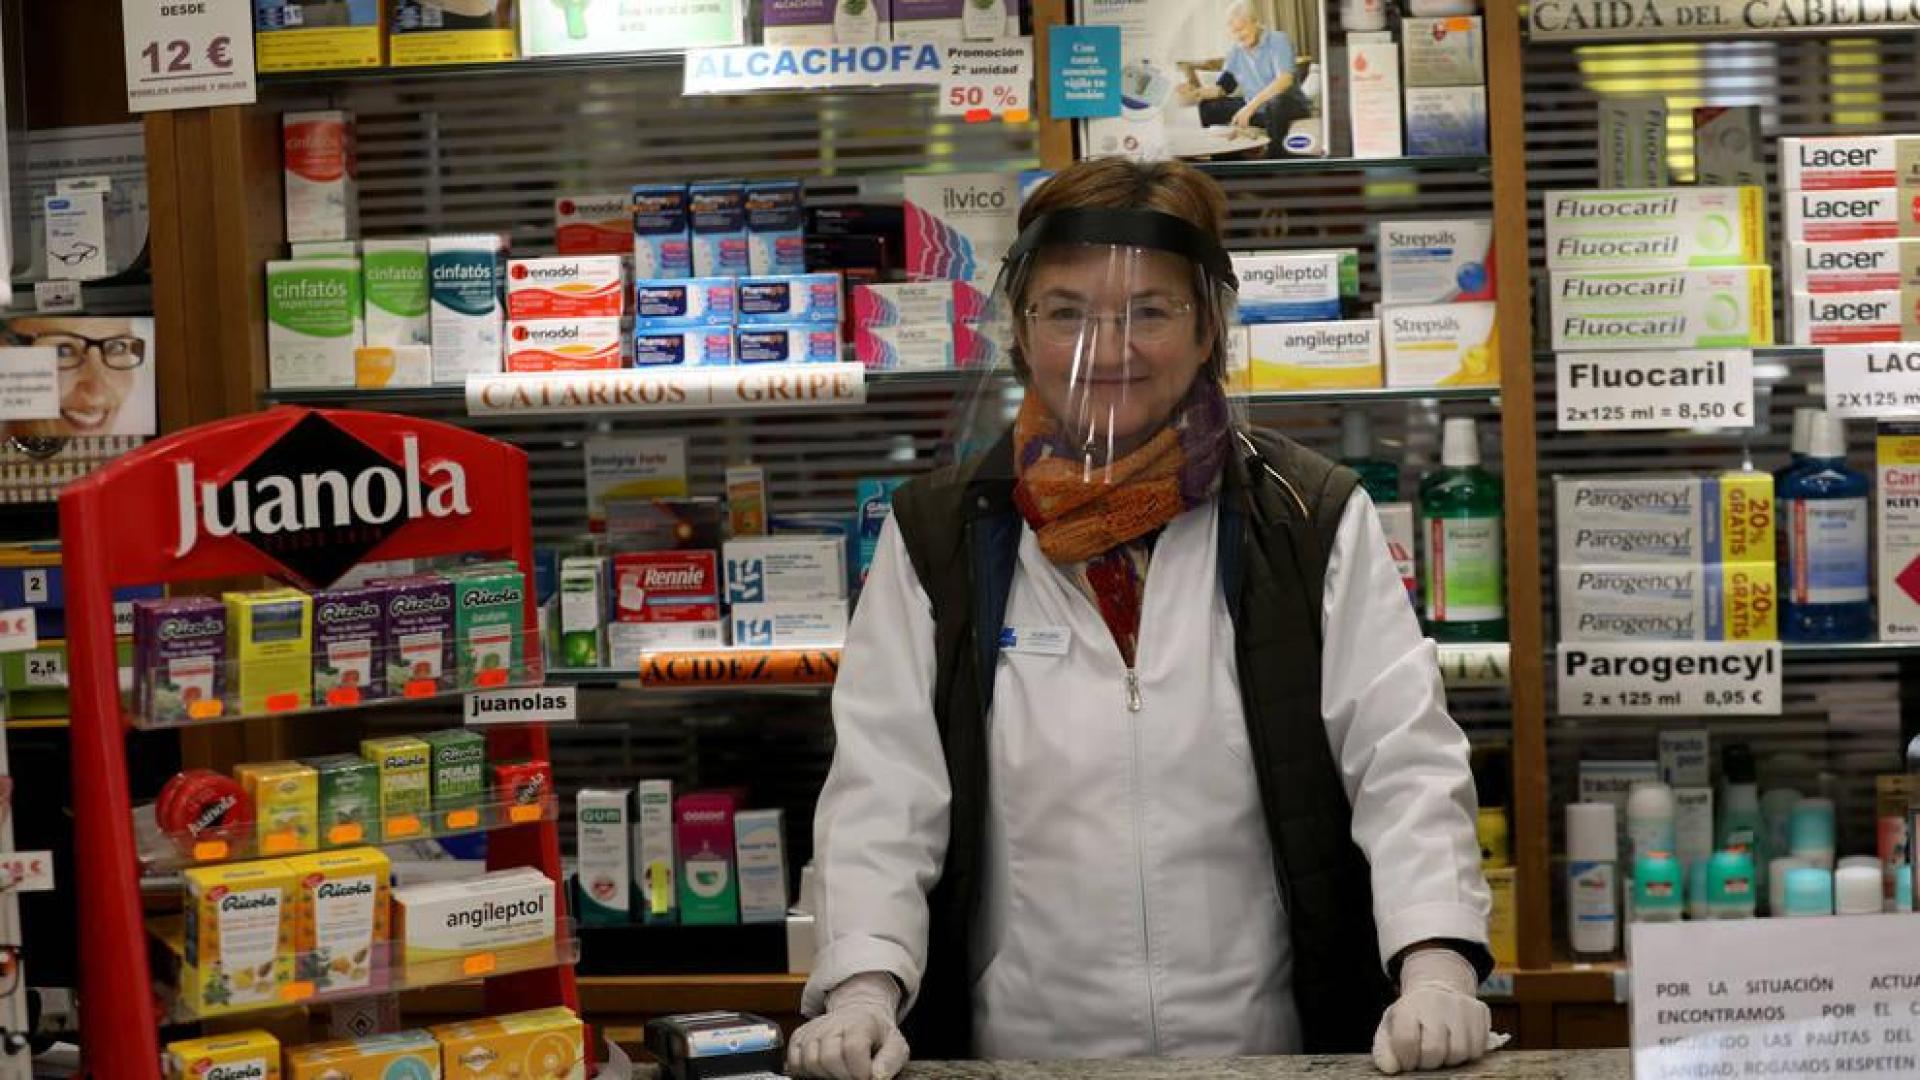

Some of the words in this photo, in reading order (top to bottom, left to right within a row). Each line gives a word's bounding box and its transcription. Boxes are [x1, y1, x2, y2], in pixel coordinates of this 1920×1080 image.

[160, 3, 206, 17] DESDE
[1534, 2, 1663, 31] CAIDA
[141, 40, 193, 73] 12
[205, 36, 234, 69] €
[695, 44, 942, 80] ALCACHOFA
[948, 46, 1025, 59] Promoción
[970, 63, 1018, 75] unidad
[949, 86, 983, 106] 50
[992, 86, 1018, 106] %
[1800, 145, 1878, 168] Lacer
[944, 186, 1006, 208] ilvico
[1555, 198, 1677, 218] Fluocaril
[1802, 197, 1880, 218] Lacer
[1389, 232, 1457, 248] Strepsils
[1557, 236, 1679, 257] Fluocaril
[1806, 248, 1885, 270] Lacer
[434, 263, 490, 279] cinfatós
[1242, 264, 1329, 285] angileptol
[273, 279, 347, 298] cinfatós
[1562, 278, 1685, 298] Fluocaril
[1809, 299, 1887, 321] Lacer
[1393, 317, 1460, 333] Strepsils
[1564, 317, 1687, 337] Fluocaril
[1284, 331, 1370, 350] angileptol
[1569, 361, 1726, 388] Fluocaril
[481, 378, 687, 409] CATARROS
[736, 371, 855, 402] GRIPE
[1566, 407, 1624, 421] 2x125
[1631, 405, 1654, 420] ml
[1679, 402, 1726, 421] 8,50
[1734, 402, 1747, 417] €
[174, 433, 471, 558] Juanola
[1575, 487, 1691, 511] Parogencyl
[1729, 487, 1747, 557] GRATIS
[1748, 498, 1771, 545] 20%
[1576, 529, 1692, 552] Parogencyl
[30, 577, 40, 590] 2
[644, 566, 705, 587] Rennie
[1577, 572, 1693, 595] Parogencyl
[390, 594, 450, 616] Ricola
[462, 589, 520, 608] Ricola
[1731, 571, 1749, 639] GRATIS
[1750, 583, 1773, 629] 20%
[319, 601, 380, 623] Ricola
[159, 618, 224, 641] Ricola
[1578, 612, 1694, 635] Parogencyl
[30, 661, 56, 676] 2,5
[648, 656, 772, 682] ACIDEZ
[1566, 648, 1774, 682] Parogencyl
[472, 692, 567, 716] juanolas
[1583, 692, 1594, 706] 2
[1600, 695, 1610, 706] x
[1619, 692, 1653, 706] 125
[1658, 691, 1681, 705] ml
[1705, 691, 1745, 706] 8,95
[1752, 690, 1763, 704] €
[582, 808, 621, 823] GUM
[318, 881, 373, 899] Ricola
[222, 894, 278, 912] Ricola
[447, 896, 544, 928] angileptol
[1656, 983, 1691, 998] POR
[1708, 982, 1728, 995] LA
[1746, 976, 1834, 995] SITUACIÓN
[1658, 1006, 1785, 1025] ENCONTRAMOS
[1822, 1004, 1857, 1018] POR
[1874, 1002, 1892, 1016] EL
[1806, 1029, 1871, 1046] PAUTAS
[1885, 1028, 1912, 1043] DEL
[1744, 1058, 1830, 1076] ROGAMOS
[1836, 1056, 1915, 1072] RESPETEN
